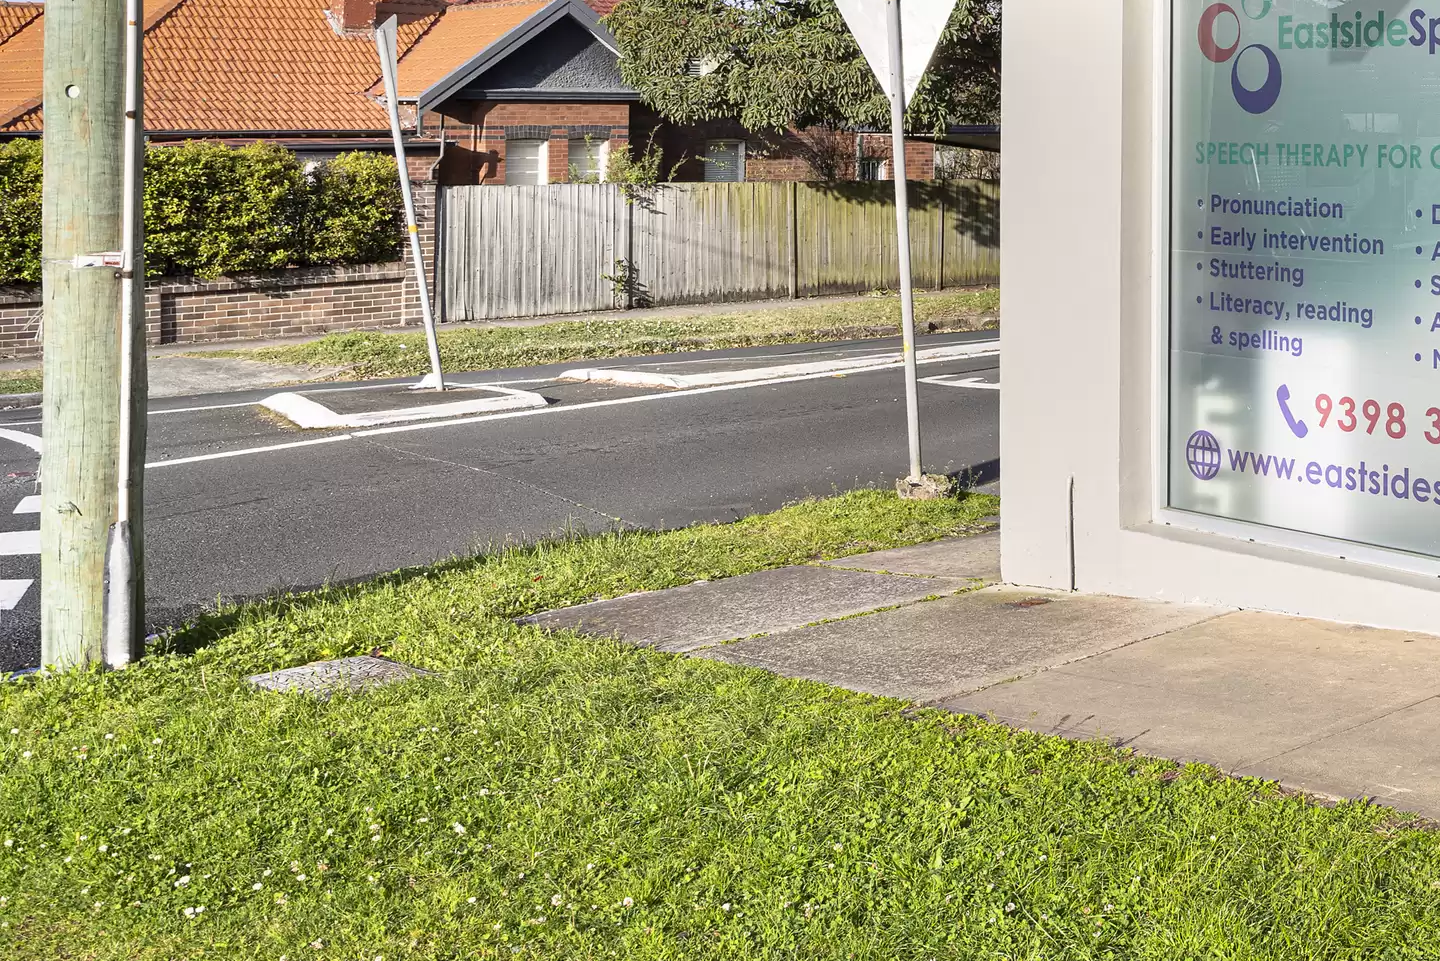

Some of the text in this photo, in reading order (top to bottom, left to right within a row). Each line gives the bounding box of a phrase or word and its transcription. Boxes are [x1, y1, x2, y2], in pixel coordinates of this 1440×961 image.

[1195, 141, 1269, 165] SPEECH
[1276, 143, 1369, 168] THERAPY
[1377, 144, 1422, 169] FOR
[1211, 194, 1343, 218] Pronunciation
[1210, 226, 1384, 255] Early intervention
[1209, 258, 1304, 287] Stuttering
[1210, 292, 1373, 329] Literacy, reading
[1211, 325, 1303, 356] & spelling
[1315, 393, 1405, 439] 9398
